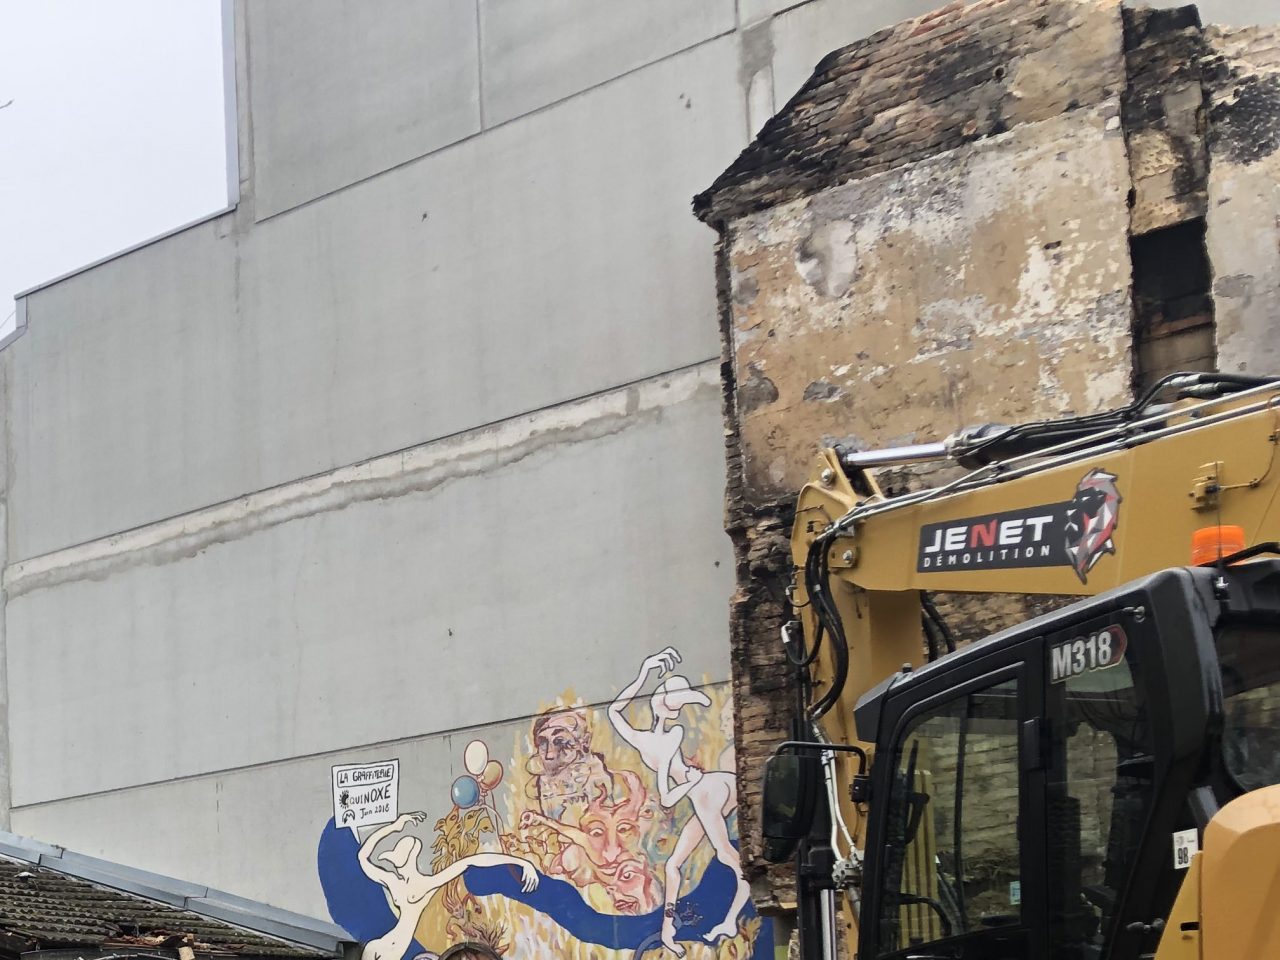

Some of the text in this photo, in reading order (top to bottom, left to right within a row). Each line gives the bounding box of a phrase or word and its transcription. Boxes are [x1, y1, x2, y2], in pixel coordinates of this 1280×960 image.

[924, 515, 1054, 553] JENET
[924, 544, 1051, 568] DÉMOLITION
[1051, 631, 1113, 680] M318
[339, 771, 349, 784] LA
